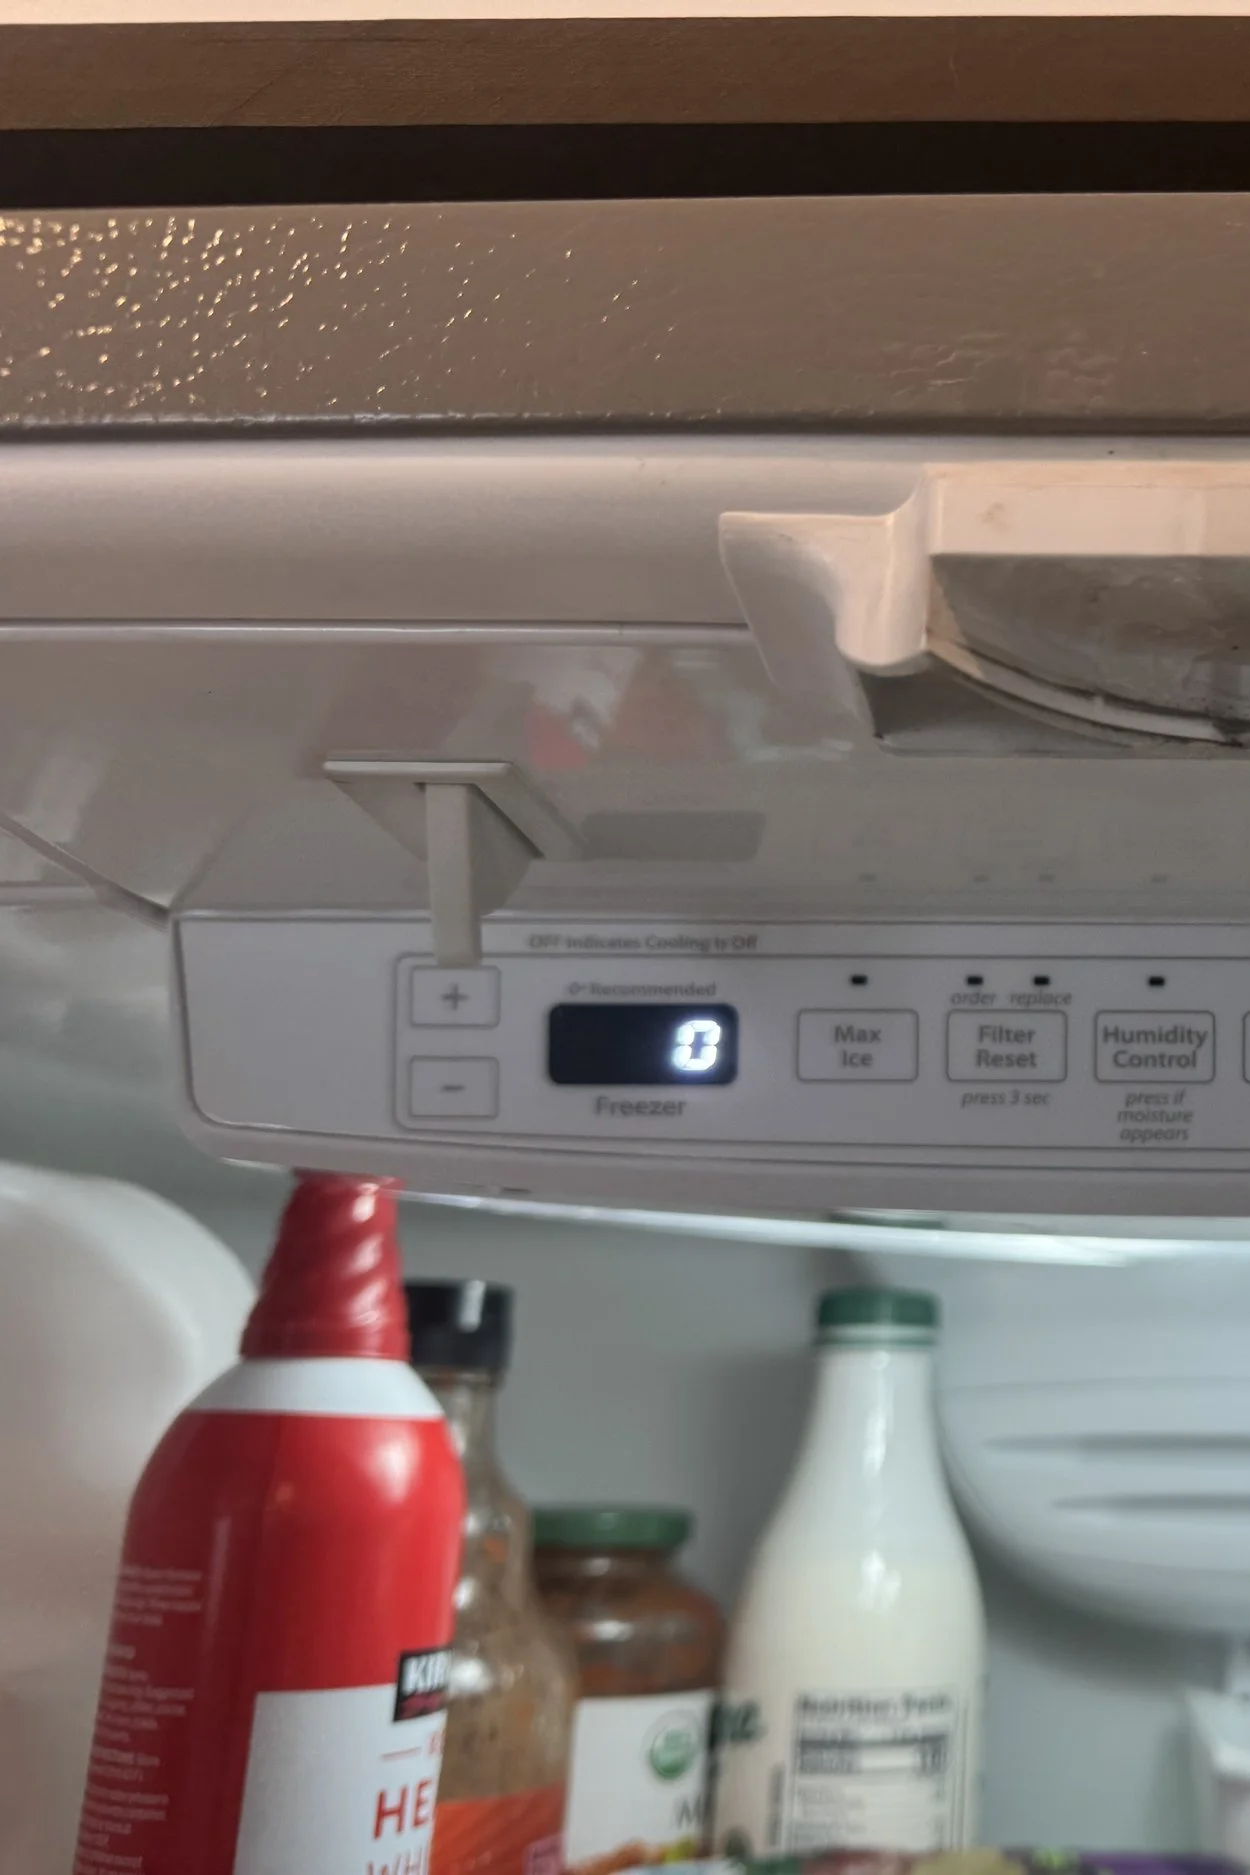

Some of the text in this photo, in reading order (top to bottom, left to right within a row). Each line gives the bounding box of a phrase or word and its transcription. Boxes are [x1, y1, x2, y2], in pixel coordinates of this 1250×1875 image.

[529, 934, 562, 949] OFF
[645, 933, 710, 952] Cooling
[590, 980, 717, 997] Recommended
[950, 989, 1072, 1009] order replace
[834, 1024, 882, 1044] Max
[978, 1024, 1036, 1044] Filter
[1103, 1025, 1208, 1049] Humidity
[672, 1019, 721, 1071] 0
[842, 1050, 873, 1068] Ice
[976, 1050, 1038, 1069] Reset
[1113, 1050, 1198, 1070] Control
[596, 1096, 686, 1117] Freezer
[961, 1090, 1051, 1108] press 3 sec
[1125, 1089, 1186, 1108] press if
[1117, 1107, 1194, 1124] moisture
[1120, 1126, 1189, 1143] appears
